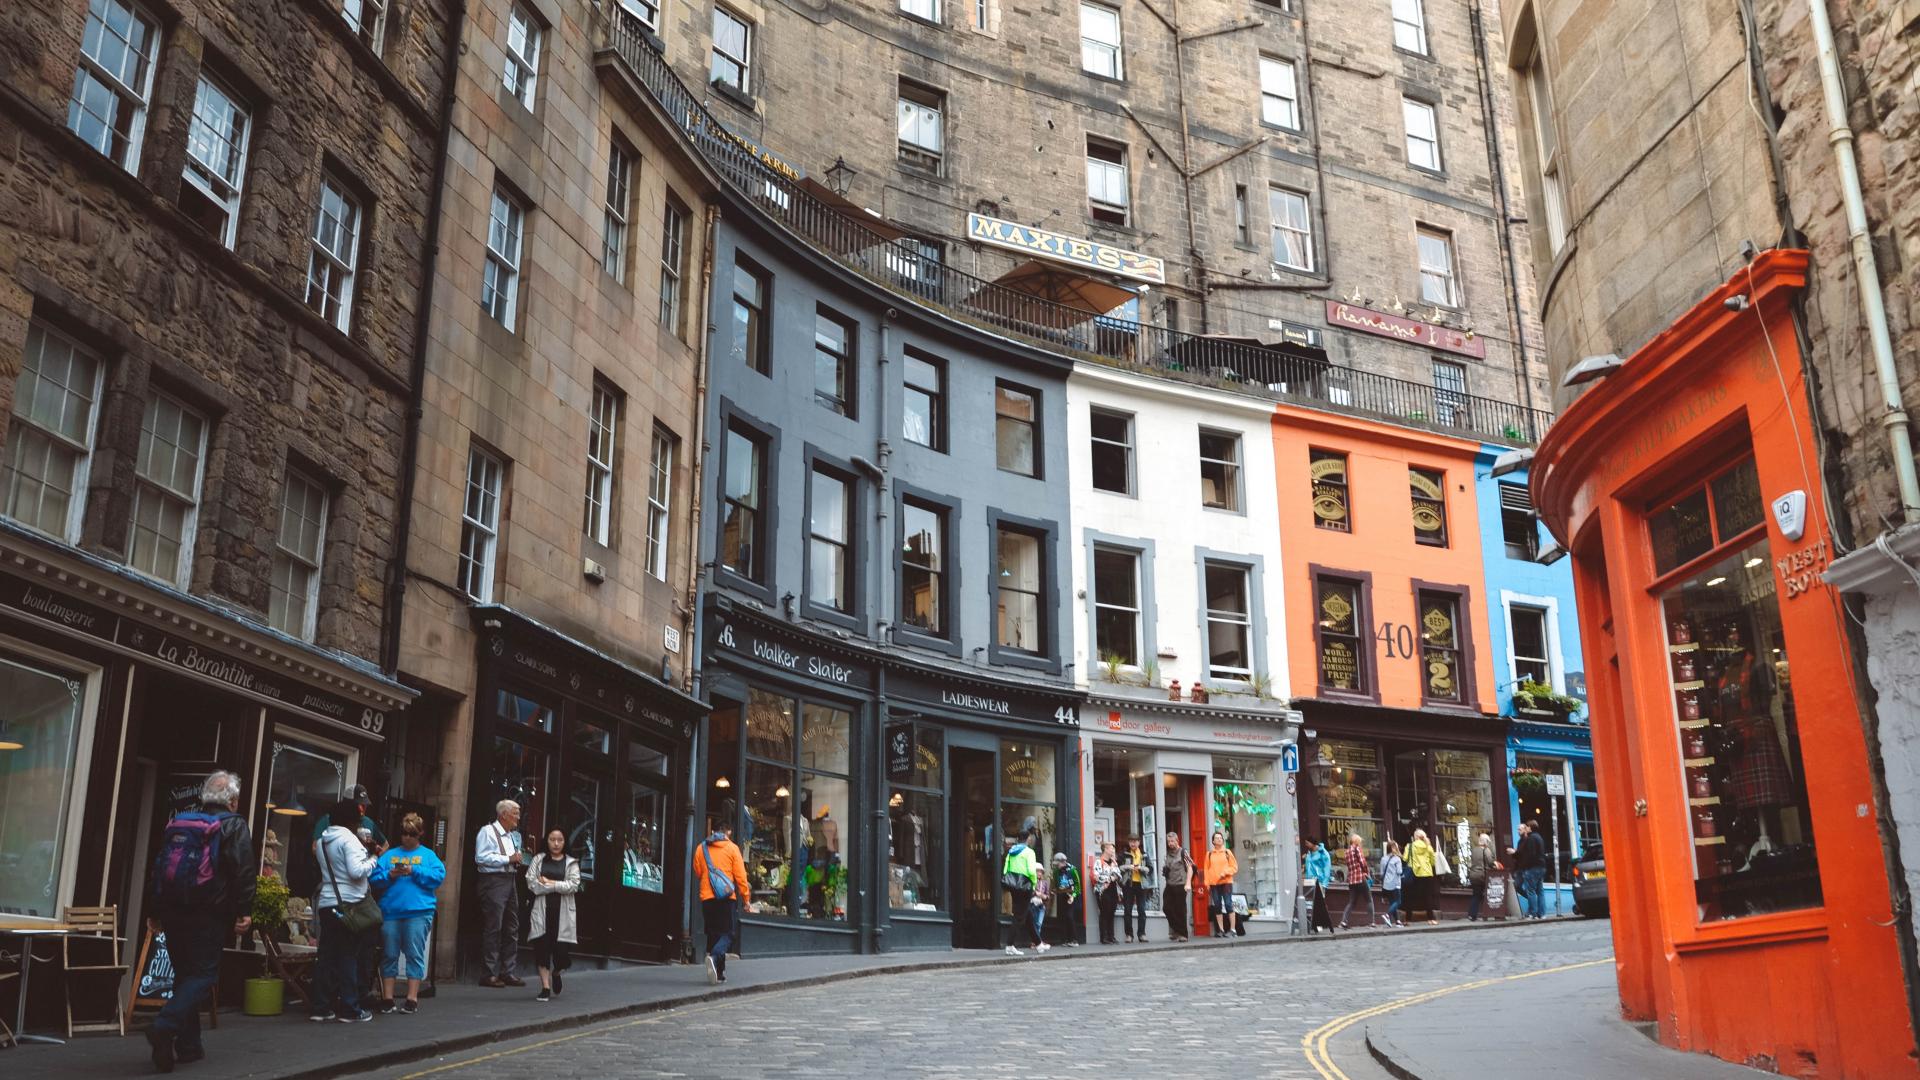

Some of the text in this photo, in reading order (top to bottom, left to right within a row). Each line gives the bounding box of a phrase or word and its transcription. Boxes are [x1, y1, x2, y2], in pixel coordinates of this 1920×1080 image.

[762, 153, 800, 180] ARMS
[975, 217, 1121, 269] MAXIES
[1776, 541, 1826, 579] WEST
[22, 586, 96, 628] boulangerie
[1429, 616, 1445, 627] BEST
[1324, 648, 1352, 658] WORLD
[1376, 622, 1414, 660] 40
[157, 636, 177, 663] La
[183, 645, 255, 688] Barantine
[753, 639, 853, 683] Walker Slater
[1429, 662, 1451, 688] 2
[302, 693, 345, 717] patisserie
[942, 689, 1010, 714] LADIESWEAR
[360, 707, 385, 734] 89
[1097, 716, 1172, 735] the red door gallery
